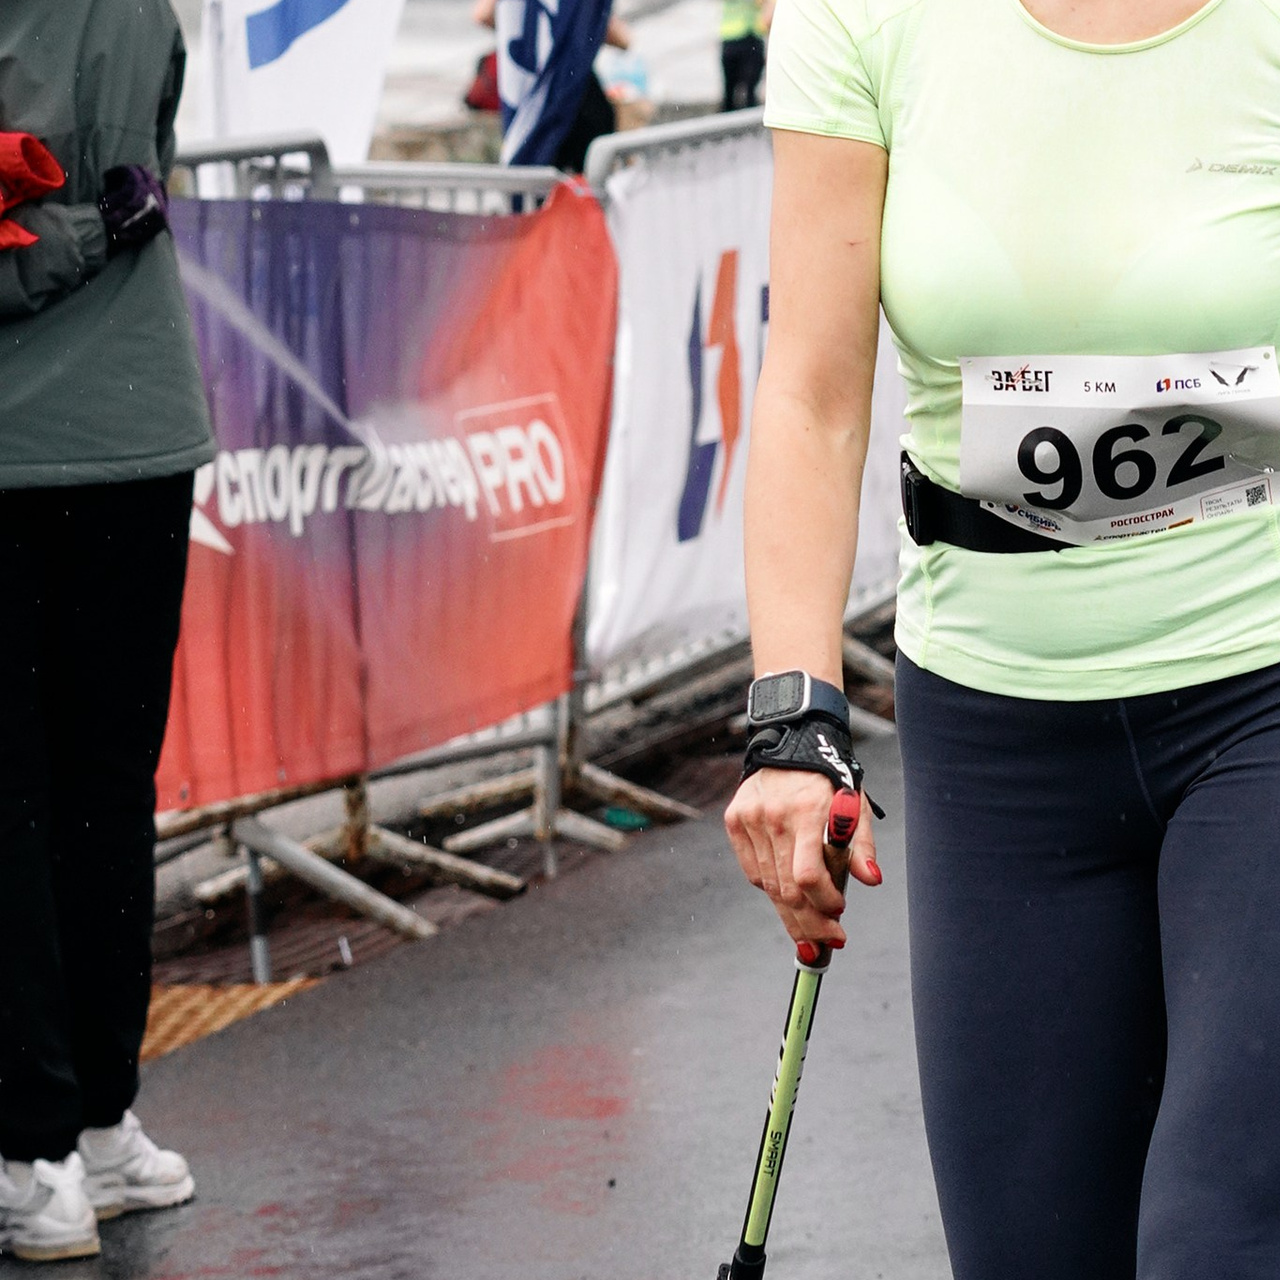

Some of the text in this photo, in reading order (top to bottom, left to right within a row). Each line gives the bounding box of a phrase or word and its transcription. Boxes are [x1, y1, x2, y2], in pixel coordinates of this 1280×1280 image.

[1208, 163, 1277, 176] DEMIX
[1084, 381, 1116, 393] 5 КМ
[1175, 378, 1201, 390] ПСБ
[1017, 414, 1225, 510] 962
[1110, 507, 1175, 528] РОСГОССТРАХ
[763, 1129, 782, 1178] SMART
